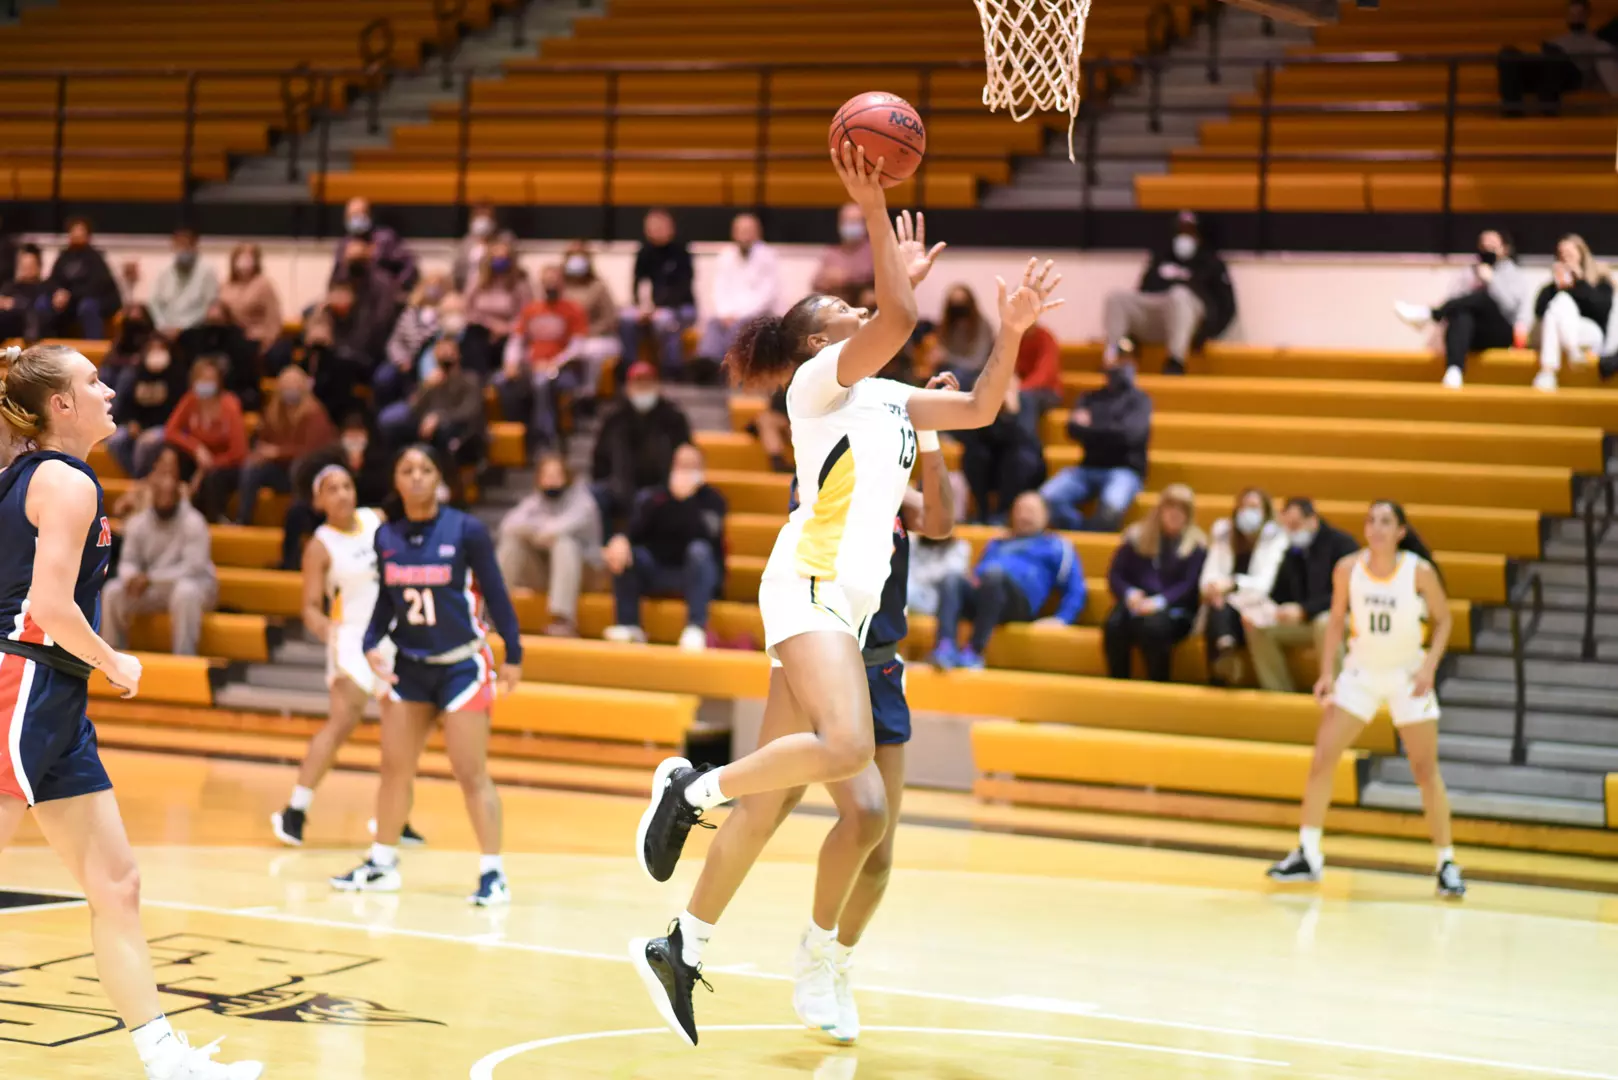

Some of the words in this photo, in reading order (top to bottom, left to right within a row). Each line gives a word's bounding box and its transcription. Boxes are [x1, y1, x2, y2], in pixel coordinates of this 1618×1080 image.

[899, 426, 915, 469] 13
[402, 587, 437, 627] 21
[1369, 612, 1391, 634] 10
